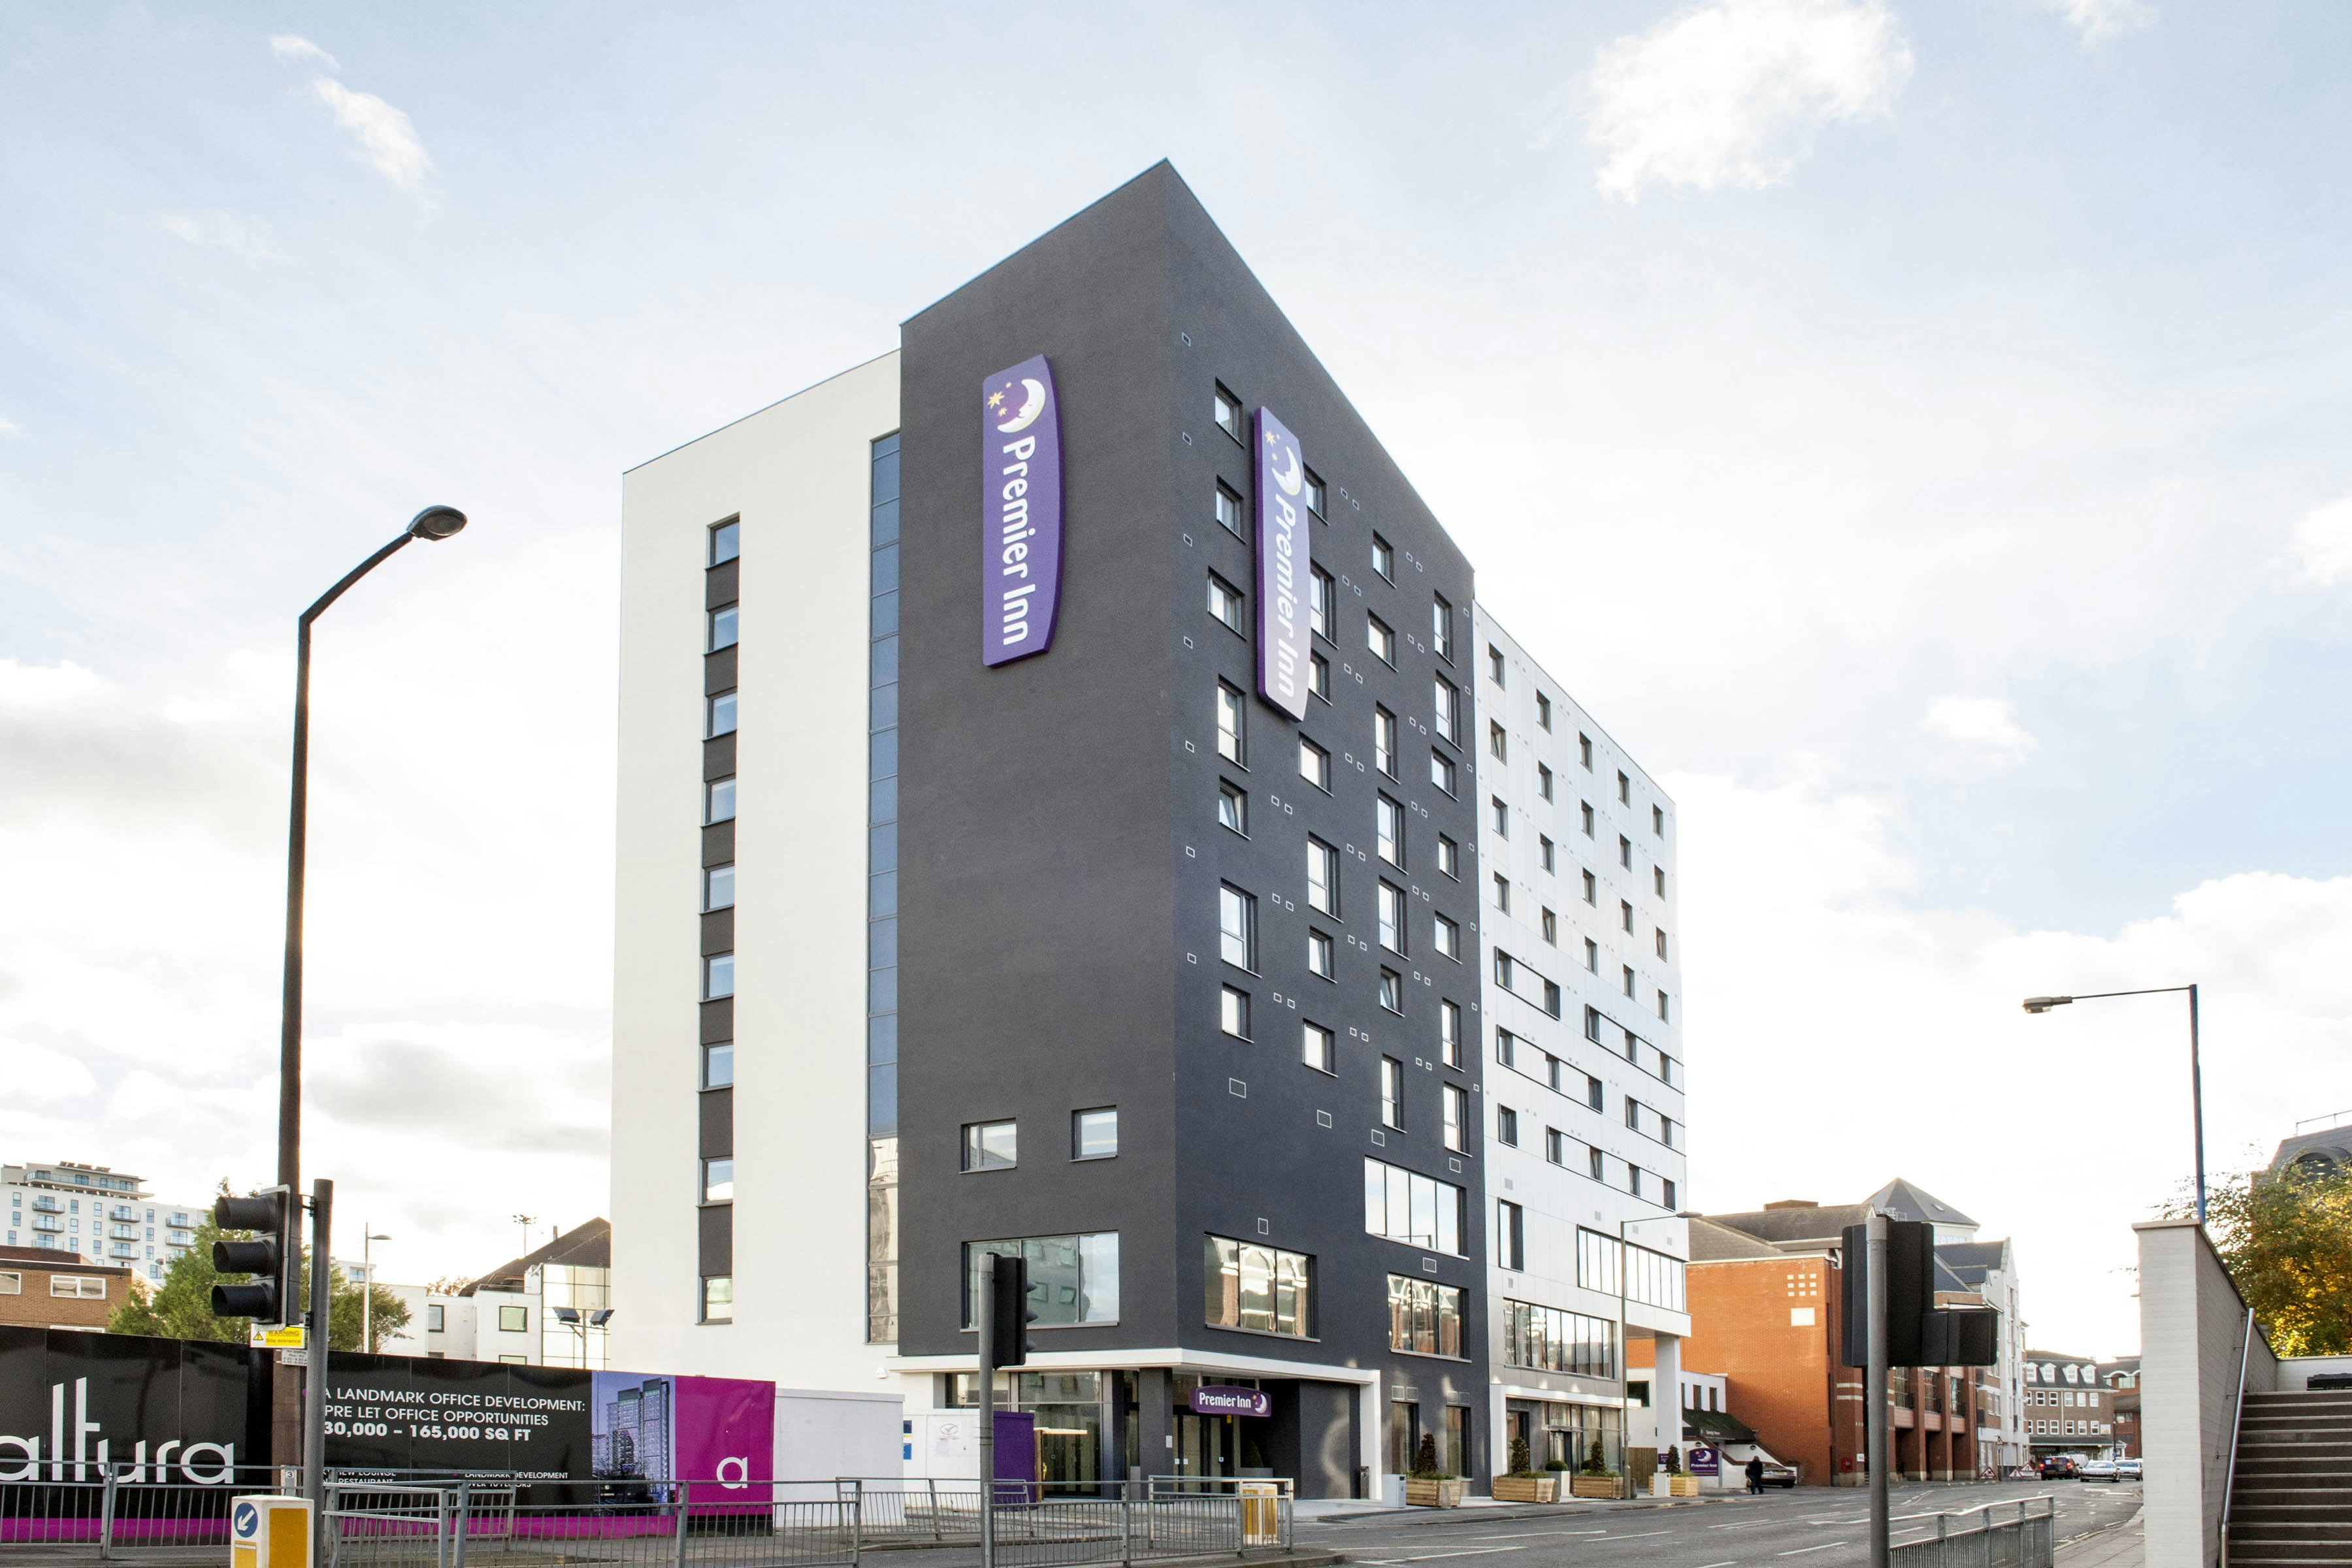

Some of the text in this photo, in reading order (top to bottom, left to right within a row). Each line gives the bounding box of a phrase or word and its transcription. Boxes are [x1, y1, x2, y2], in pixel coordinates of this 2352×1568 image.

[1003, 435, 1036, 645] Premier Inn
[1275, 493, 1299, 698] Premier Inn
[337, 1388, 425, 1403] LANDMARK
[429, 1392, 481, 1407] OFFICE
[485, 1396, 585, 1411] DEVELOPMENT:
[1199, 1392, 1251, 1408] Premier Inn
[325, 1405, 549, 1426] PRE LET OFFICE OPPORTUNITIES
[0, 1377, 234, 1484] altura
[324, 1422, 387, 1437] 30,000
[410, 1425, 480, 1441] 165,000
[485, 1427, 510, 1441] SQ
[514, 1429, 531, 1441] FT
